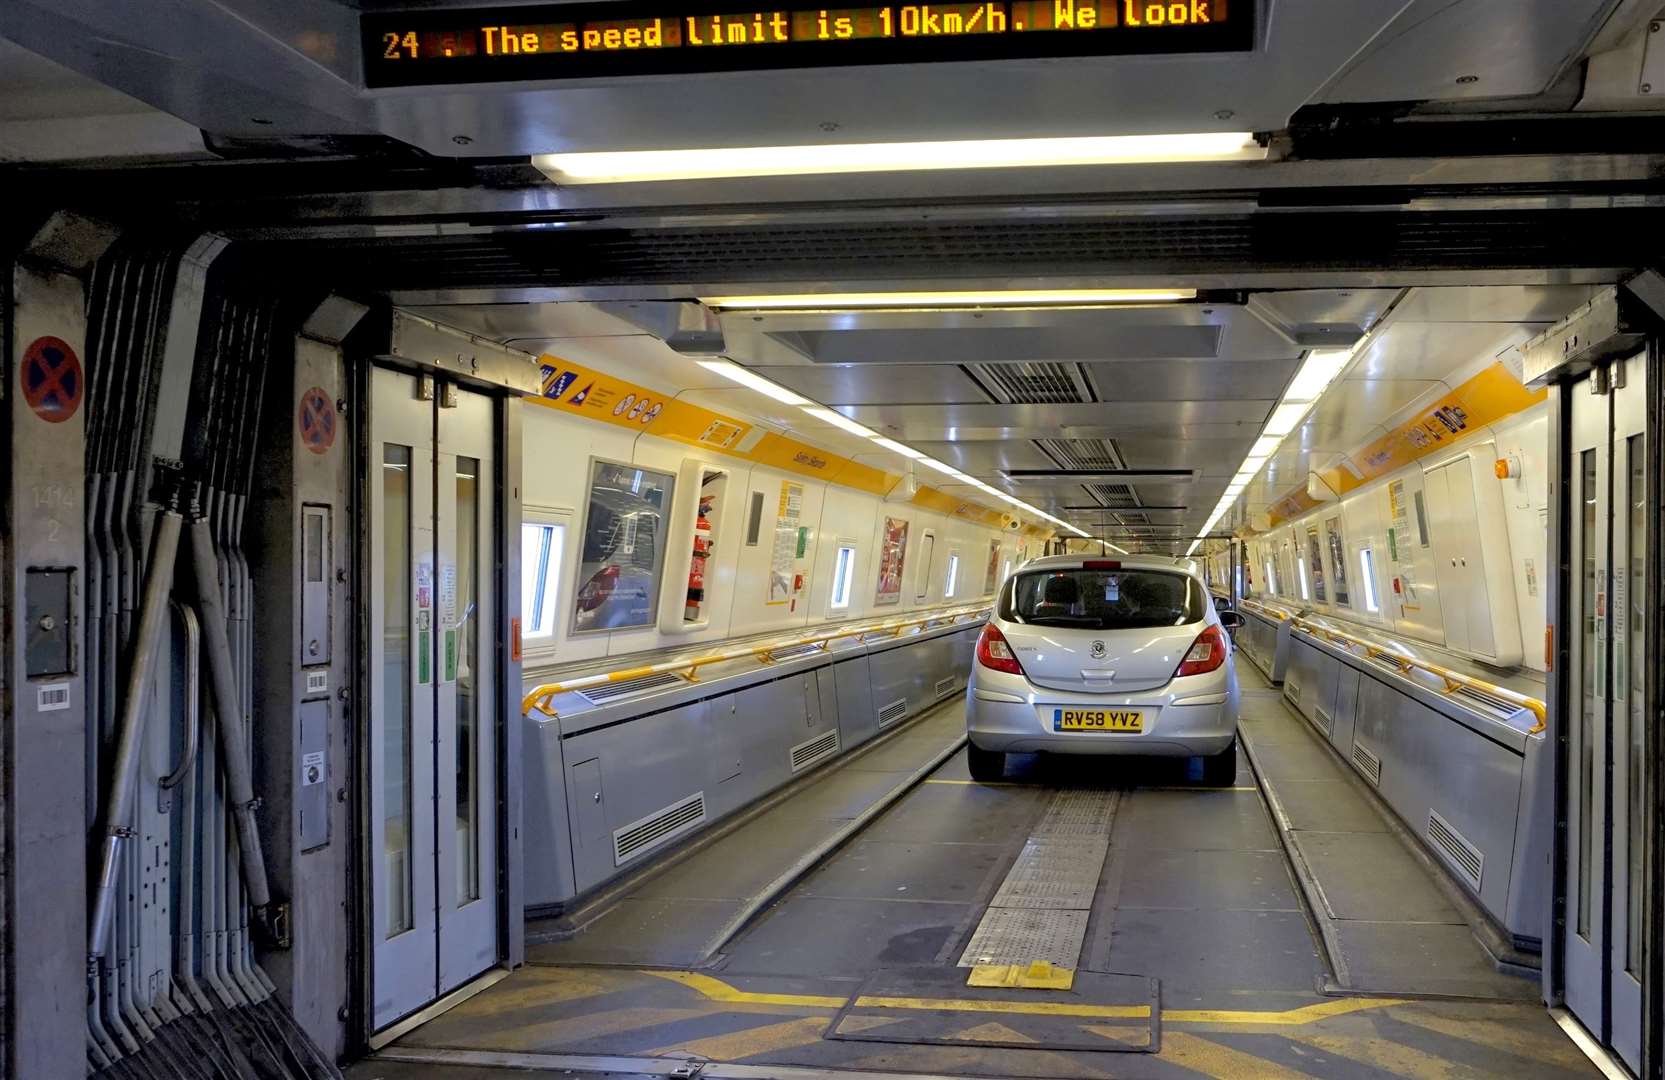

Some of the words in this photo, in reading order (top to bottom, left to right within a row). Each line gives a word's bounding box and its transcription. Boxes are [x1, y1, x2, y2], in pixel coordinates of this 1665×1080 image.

[382, 31, 419, 59] 24
[481, 26, 539, 55] The
[560, 18, 662, 51] speed
[686, 12, 789, 45] limit
[817, 10, 853, 39] is
[879, 2, 1024, 36] 10km/h.
[1054, 4, 1097, 29] We
[1124, 0, 1210, 26] look
[1064, 711, 1105, 727] RV58
[1110, 711, 1140, 728] YVZ
